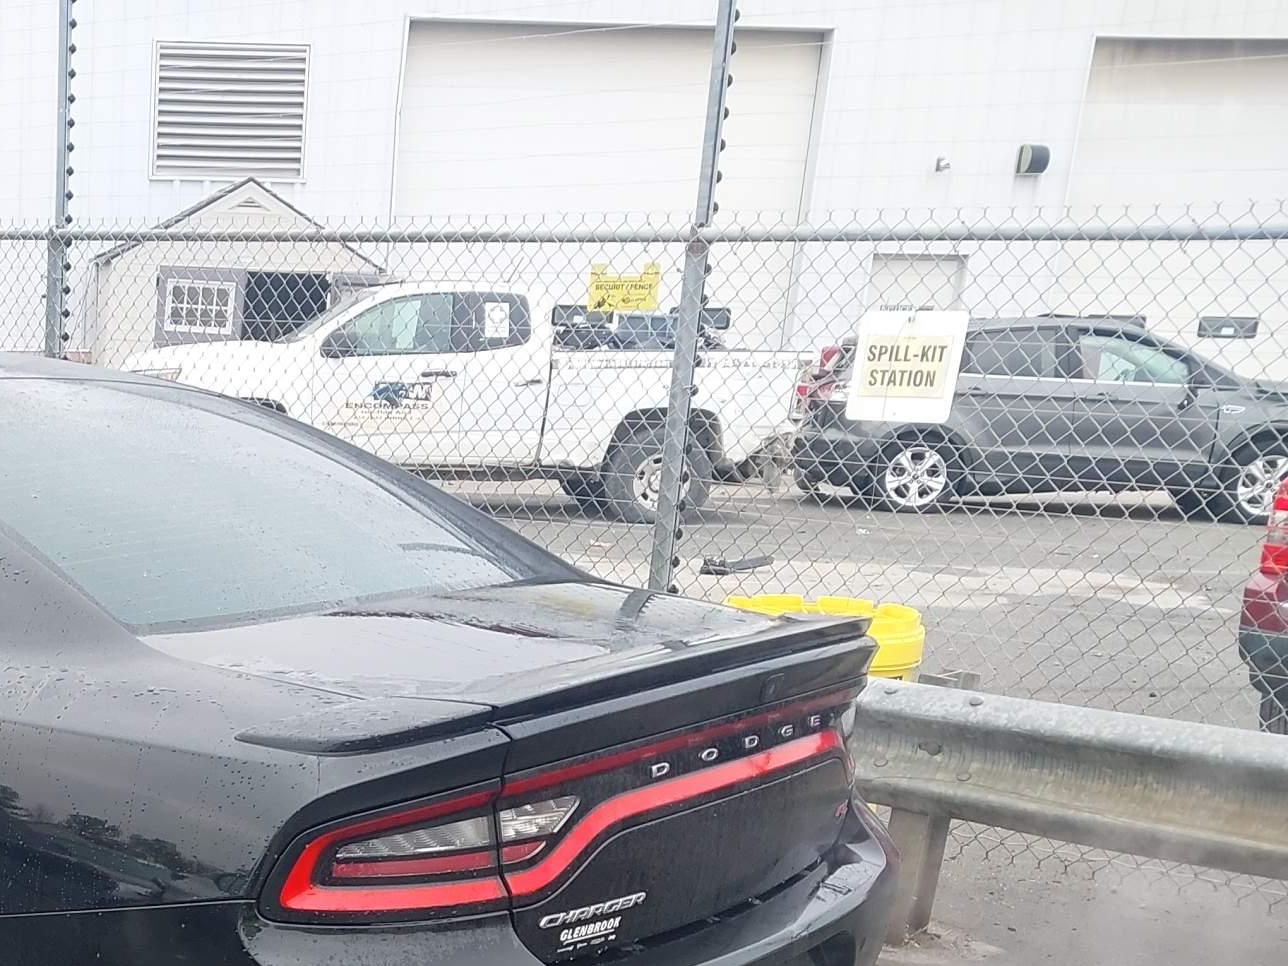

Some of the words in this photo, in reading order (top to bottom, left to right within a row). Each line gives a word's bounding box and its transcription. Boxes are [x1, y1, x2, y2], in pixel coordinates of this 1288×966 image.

[867, 344, 948, 362] SPILL-KIT
[868, 369, 937, 387] STATION
[651, 714, 821, 778] DODGE
[539, 892, 646, 929] CHARGER
[560, 916, 622, 941] GLENBROOK
